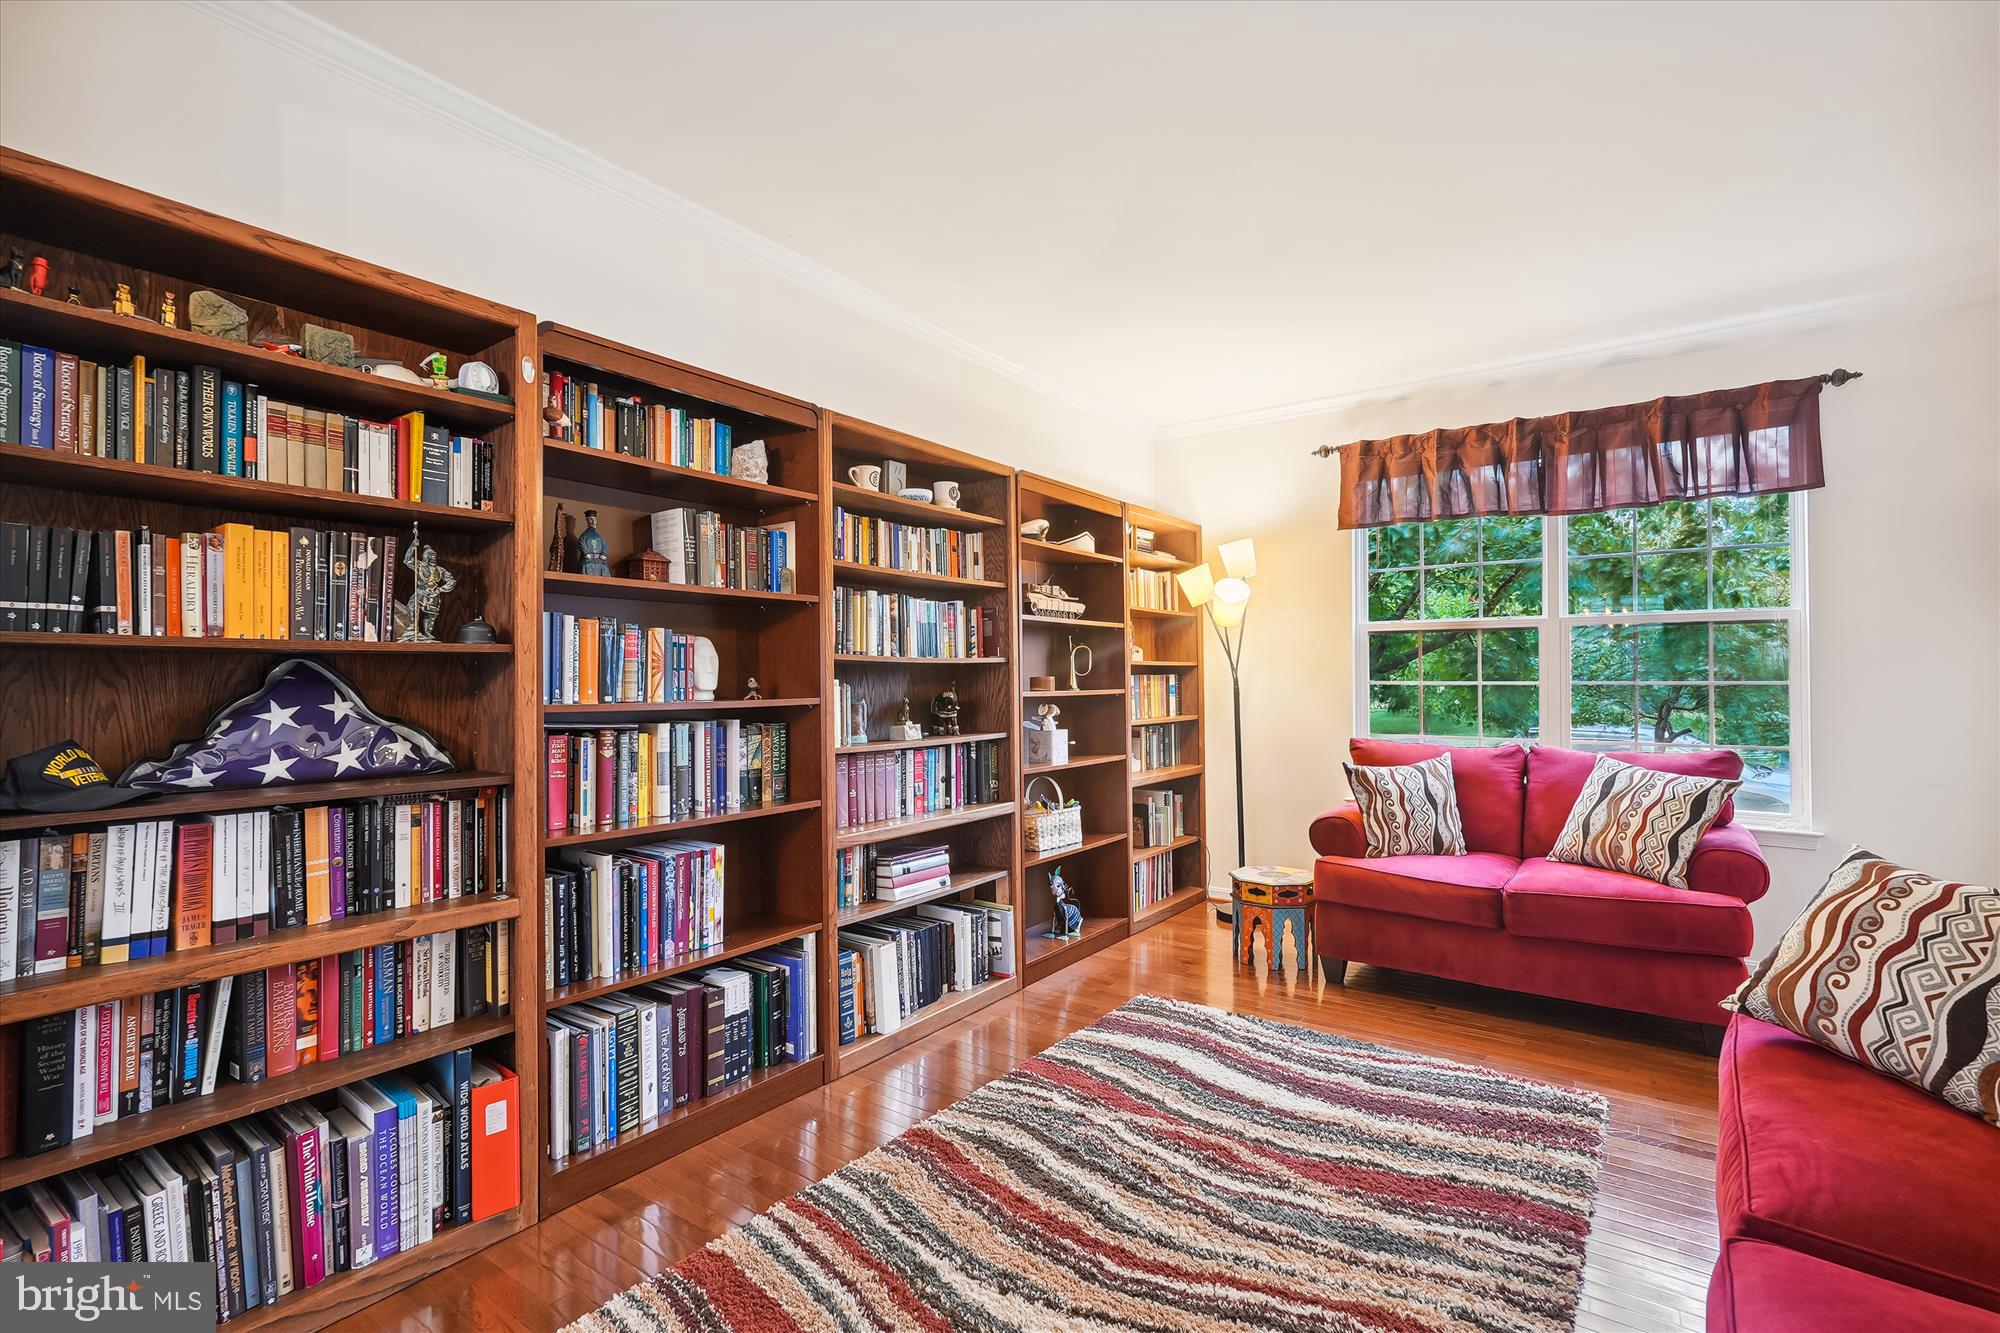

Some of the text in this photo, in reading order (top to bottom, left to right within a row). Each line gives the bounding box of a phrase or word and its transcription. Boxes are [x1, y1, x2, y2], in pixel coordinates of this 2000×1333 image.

[0, 346, 12, 425] Roots of Strategy
[32, 352, 46, 378] Roots
[32, 380, 46, 392] of
[29, 391, 46, 430] Strategy
[58, 360, 76, 444] Roots of Strategy
[180, 402, 188, 430] TOLKIEN
[202, 371, 214, 458] IN THEIR OWN WORDS
[226, 400, 236, 476] TOLKIEN BEOWULF
[186, 556, 198, 614] HERALDRY
[295, 559, 304, 605] PELOPONNESIAN
[295, 606, 304, 621] WAR
[44, 749, 78, 776] WORLD
[763, 738, 771, 781] CAESAR
[184, 828, 208, 839] THE
[292, 828, 302, 883] INHERITANCE
[333, 813, 342, 854] Constantine
[90, 838, 102, 884] SPARTANS
[452, 863, 460, 891] ANTIQUITY
[21, 867, 32, 909] A.D. 381
[182, 868, 210, 913] CHRONOLOGY
[294, 888, 303, 912] ROME
[383, 944, 394, 994] ALISMAN
[187, 993, 200, 1024] Secrets
[273, 981, 284, 1054] BARBARIANS
[284, 983, 294, 1029] EMPIRES
[99, 1009, 111, 1094] THE MAKING OF STRATEGY
[126, 1016, 136, 1081] ANCIENT ROME
[676, 1007, 687, 1057] AGGIELAND '78
[183, 1038, 199, 1080] SAMURAI
[661, 1026, 670, 1093] The Art of War
[460, 1080, 468, 1170] WIDE WORLD ATLAS
[260, 1179, 268, 1203] STAR
[301, 1136, 318, 1227] The White House
[358, 1142, 370, 1227] MANNED SUBMERSIBLES
[379, 1154, 387, 1189] OCEAN
[388, 1126, 398, 1226] JACQUES COUSTEAU
[221, 1163, 238, 1248] Medieval warfare
[262, 1201, 271, 1224] TREK
[380, 1194, 388, 1230] WORLD
[72, 1240, 83, 1260] 1995
[130, 1225, 142, 1262] ENDURIN
[151, 1196, 167, 1262] GREECE AND RO
